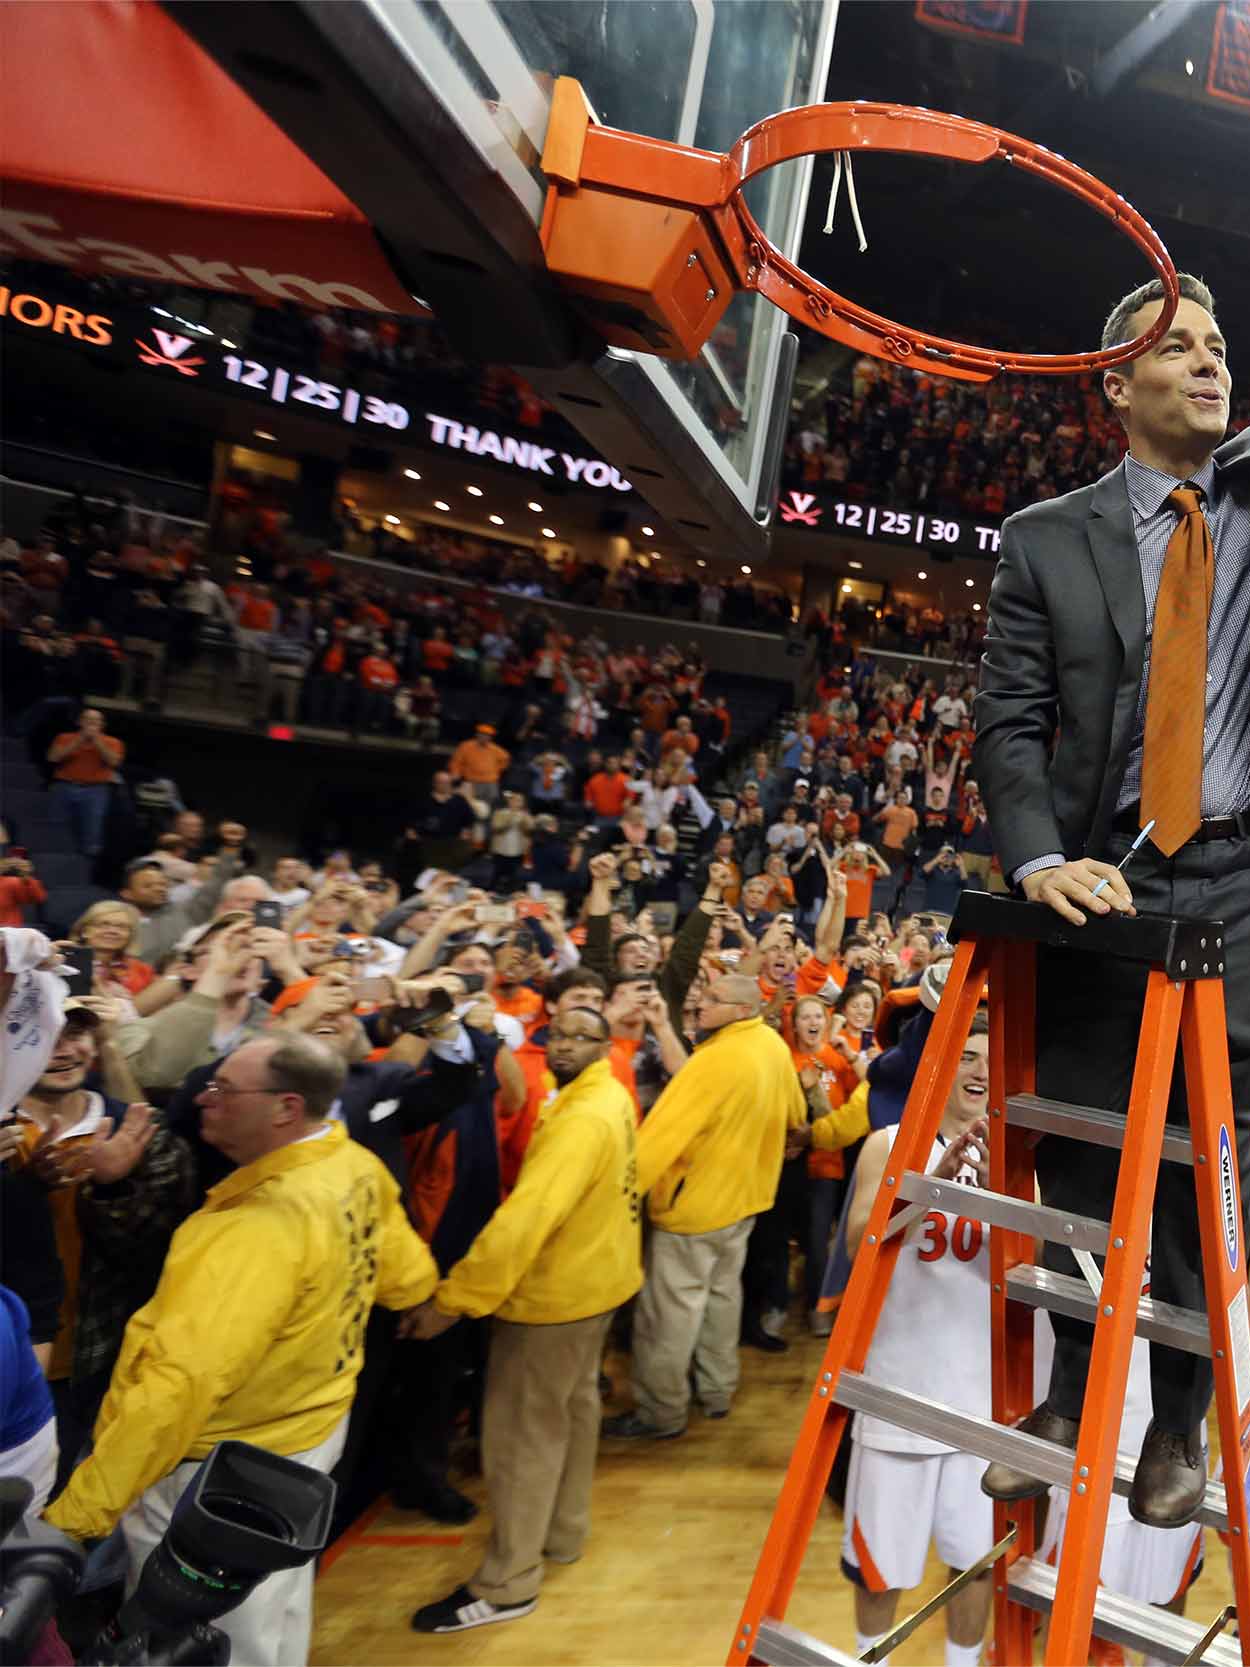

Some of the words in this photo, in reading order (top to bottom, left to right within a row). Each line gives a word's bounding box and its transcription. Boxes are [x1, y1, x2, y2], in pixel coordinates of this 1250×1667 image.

[0, 206, 395, 314] Farm
[424, 412, 557, 476] THANK
[917, 1211, 982, 1262] 30
[1222, 1156, 1236, 1243] WERNER
